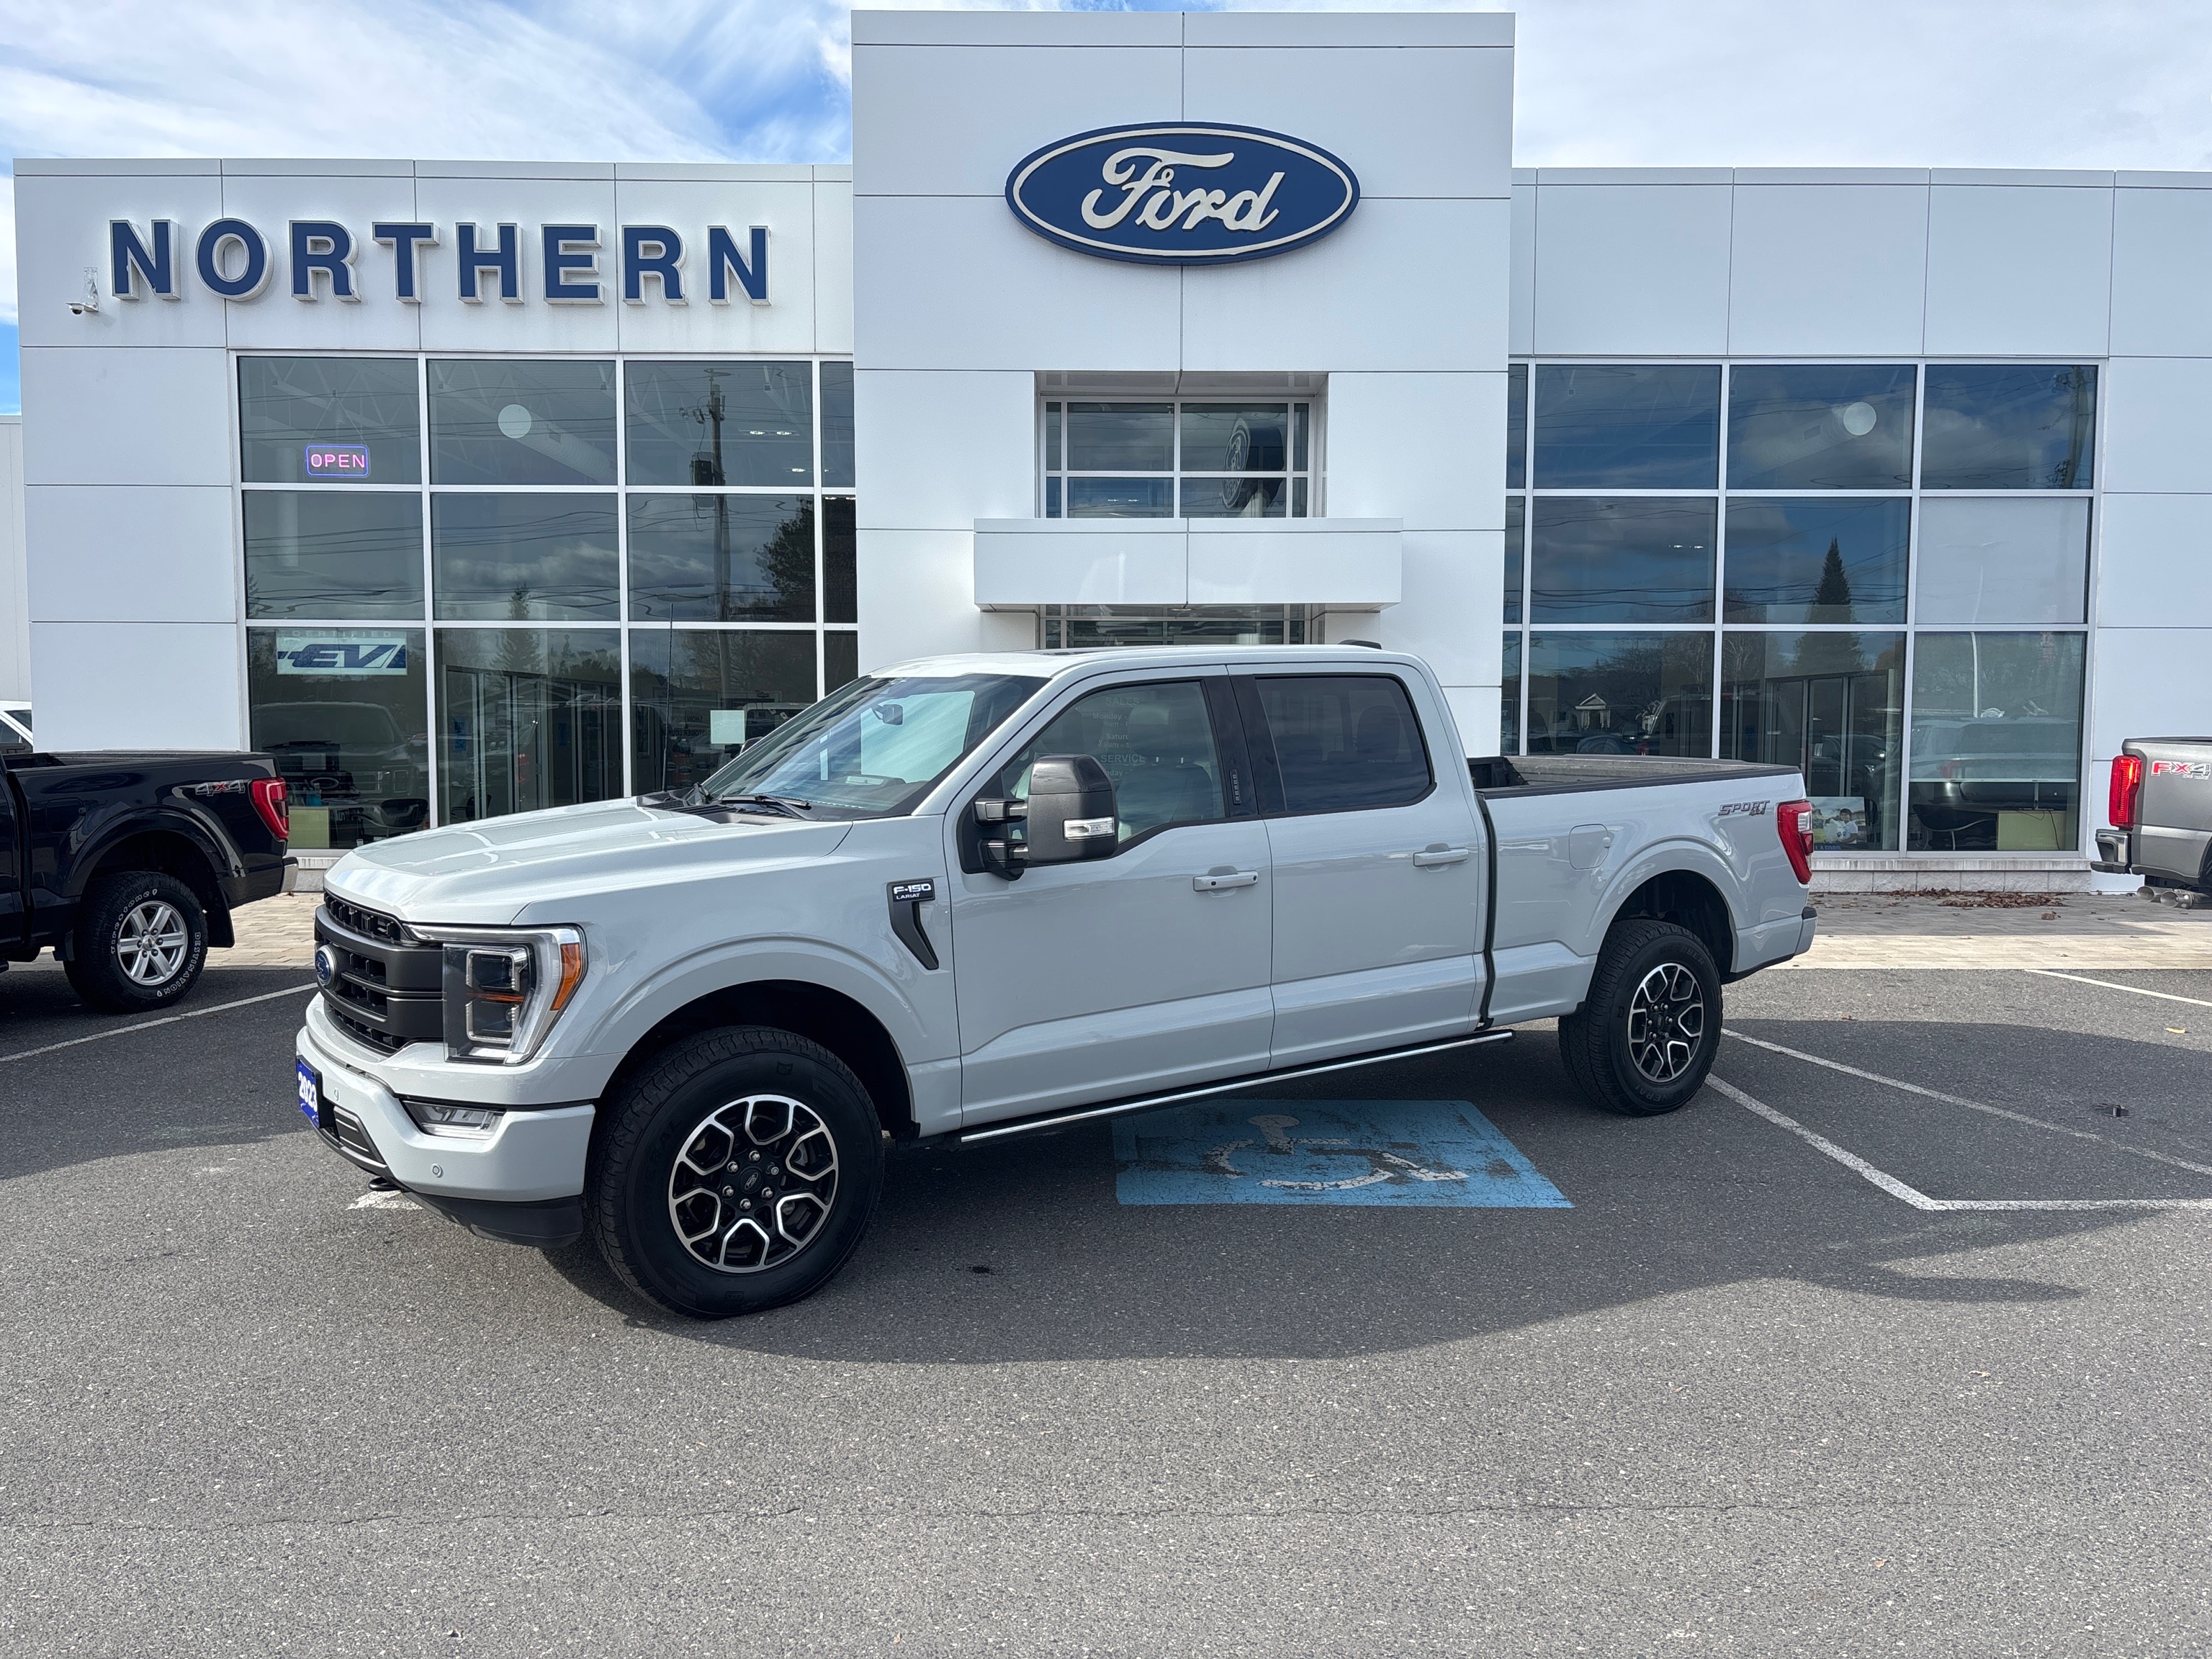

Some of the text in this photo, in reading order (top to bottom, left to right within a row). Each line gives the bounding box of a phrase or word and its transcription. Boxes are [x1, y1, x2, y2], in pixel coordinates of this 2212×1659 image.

[1081, 147, 1285, 231] Ford
[109, 217, 771, 306] NORTHERN
[310, 454, 365, 468] OPEN
[1105, 697, 1140, 706] SALES
[2151, 760, 2211, 777] FX4
[1717, 800, 1771, 816] SPORT
[893, 884, 932, 894] F-150
[163, 932, 202, 995] DESTINATION
[298, 1071, 318, 1112] 2023
